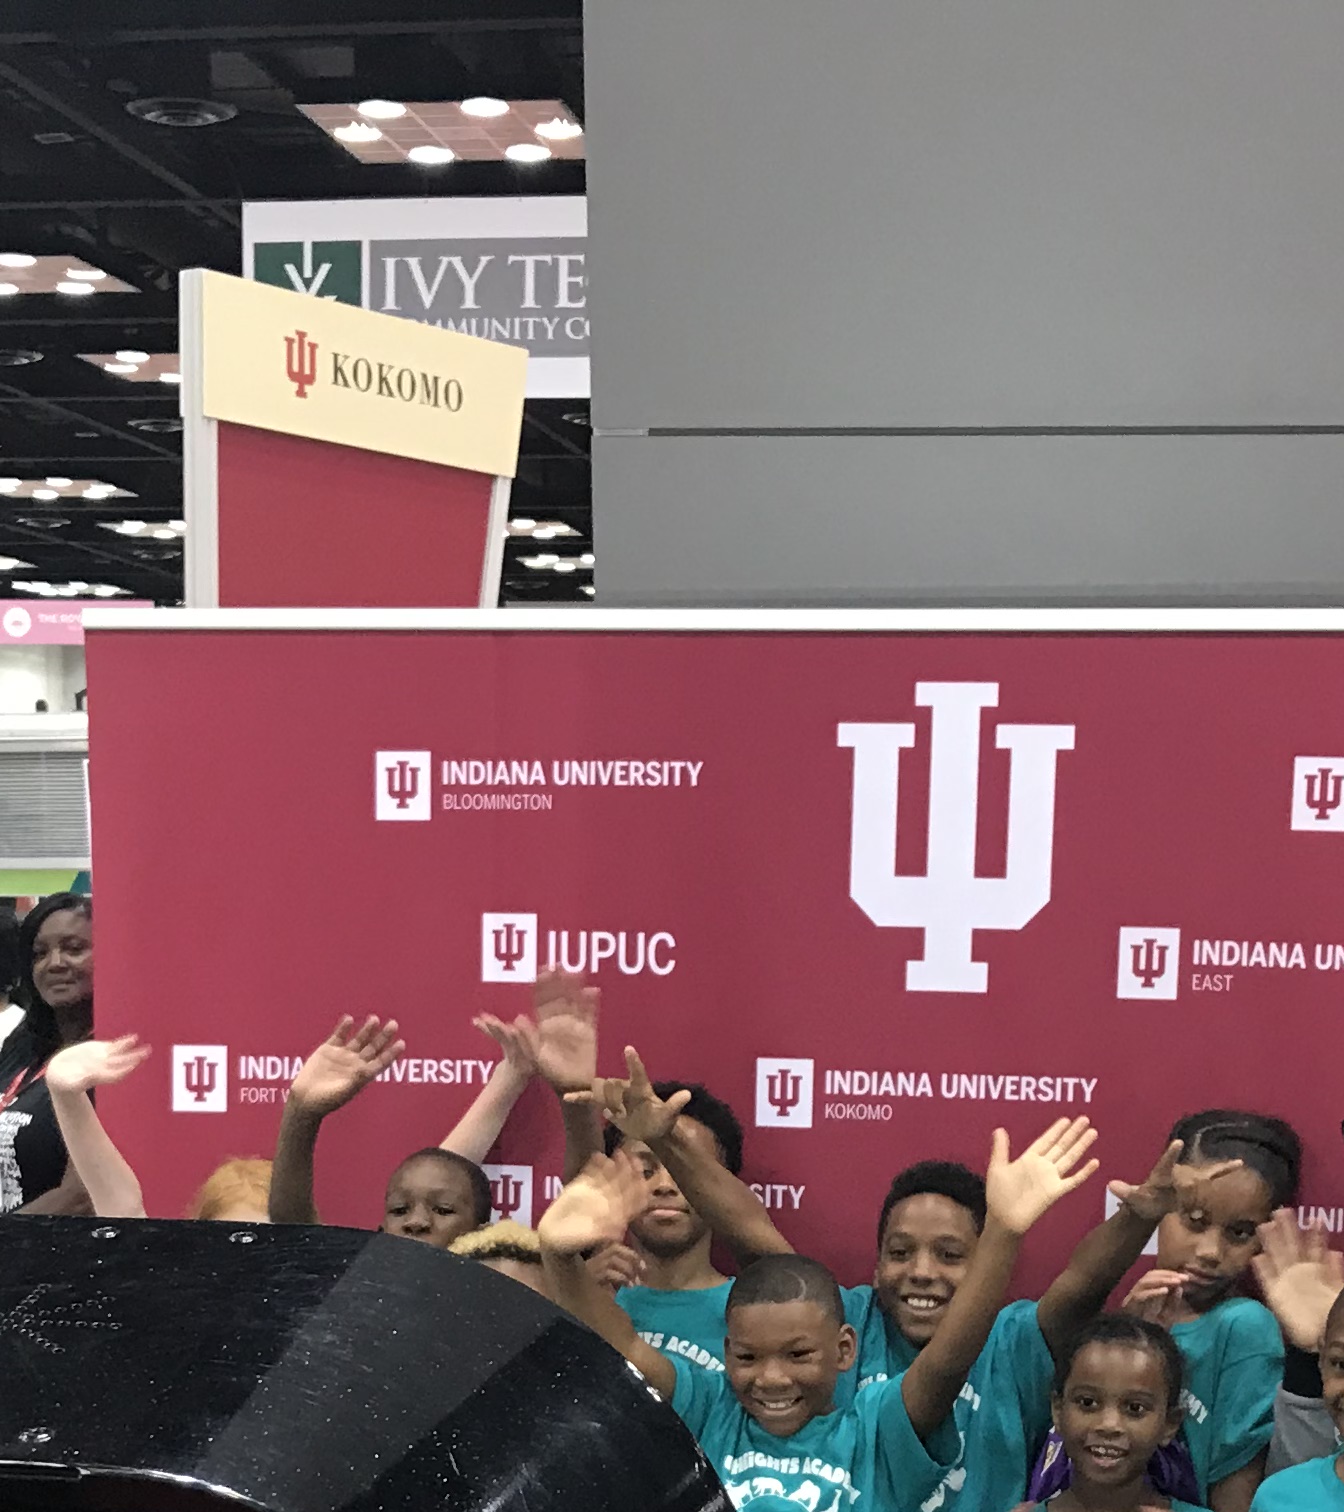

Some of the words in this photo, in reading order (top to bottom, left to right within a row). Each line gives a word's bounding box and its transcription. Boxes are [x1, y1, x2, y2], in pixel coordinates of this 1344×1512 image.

[380, 254, 495, 311] IVY
[508, 253, 587, 309] TE
[331, 351, 464, 413] KOKOMO
[442, 760, 546, 786] INDIANA
[552, 760, 704, 787] UNIVERSITY
[442, 793, 553, 811] BLOOMINGTON
[547, 930, 677, 976] IUPUC
[1192, 939, 1307, 970] INDIANA
[1191, 973, 1234, 993] EAST
[239, 1055, 305, 1081] INDIA
[376, 1057, 494, 1085] IVERSITY
[240, 1087, 276, 1105] FORT
[824, 1069, 934, 1099] INDIANA
[940, 1073, 1099, 1104] UNIVERSITY
[824, 1102, 893, 1122] KOKOMO
[665, 1335, 726, 1372] ACADE
